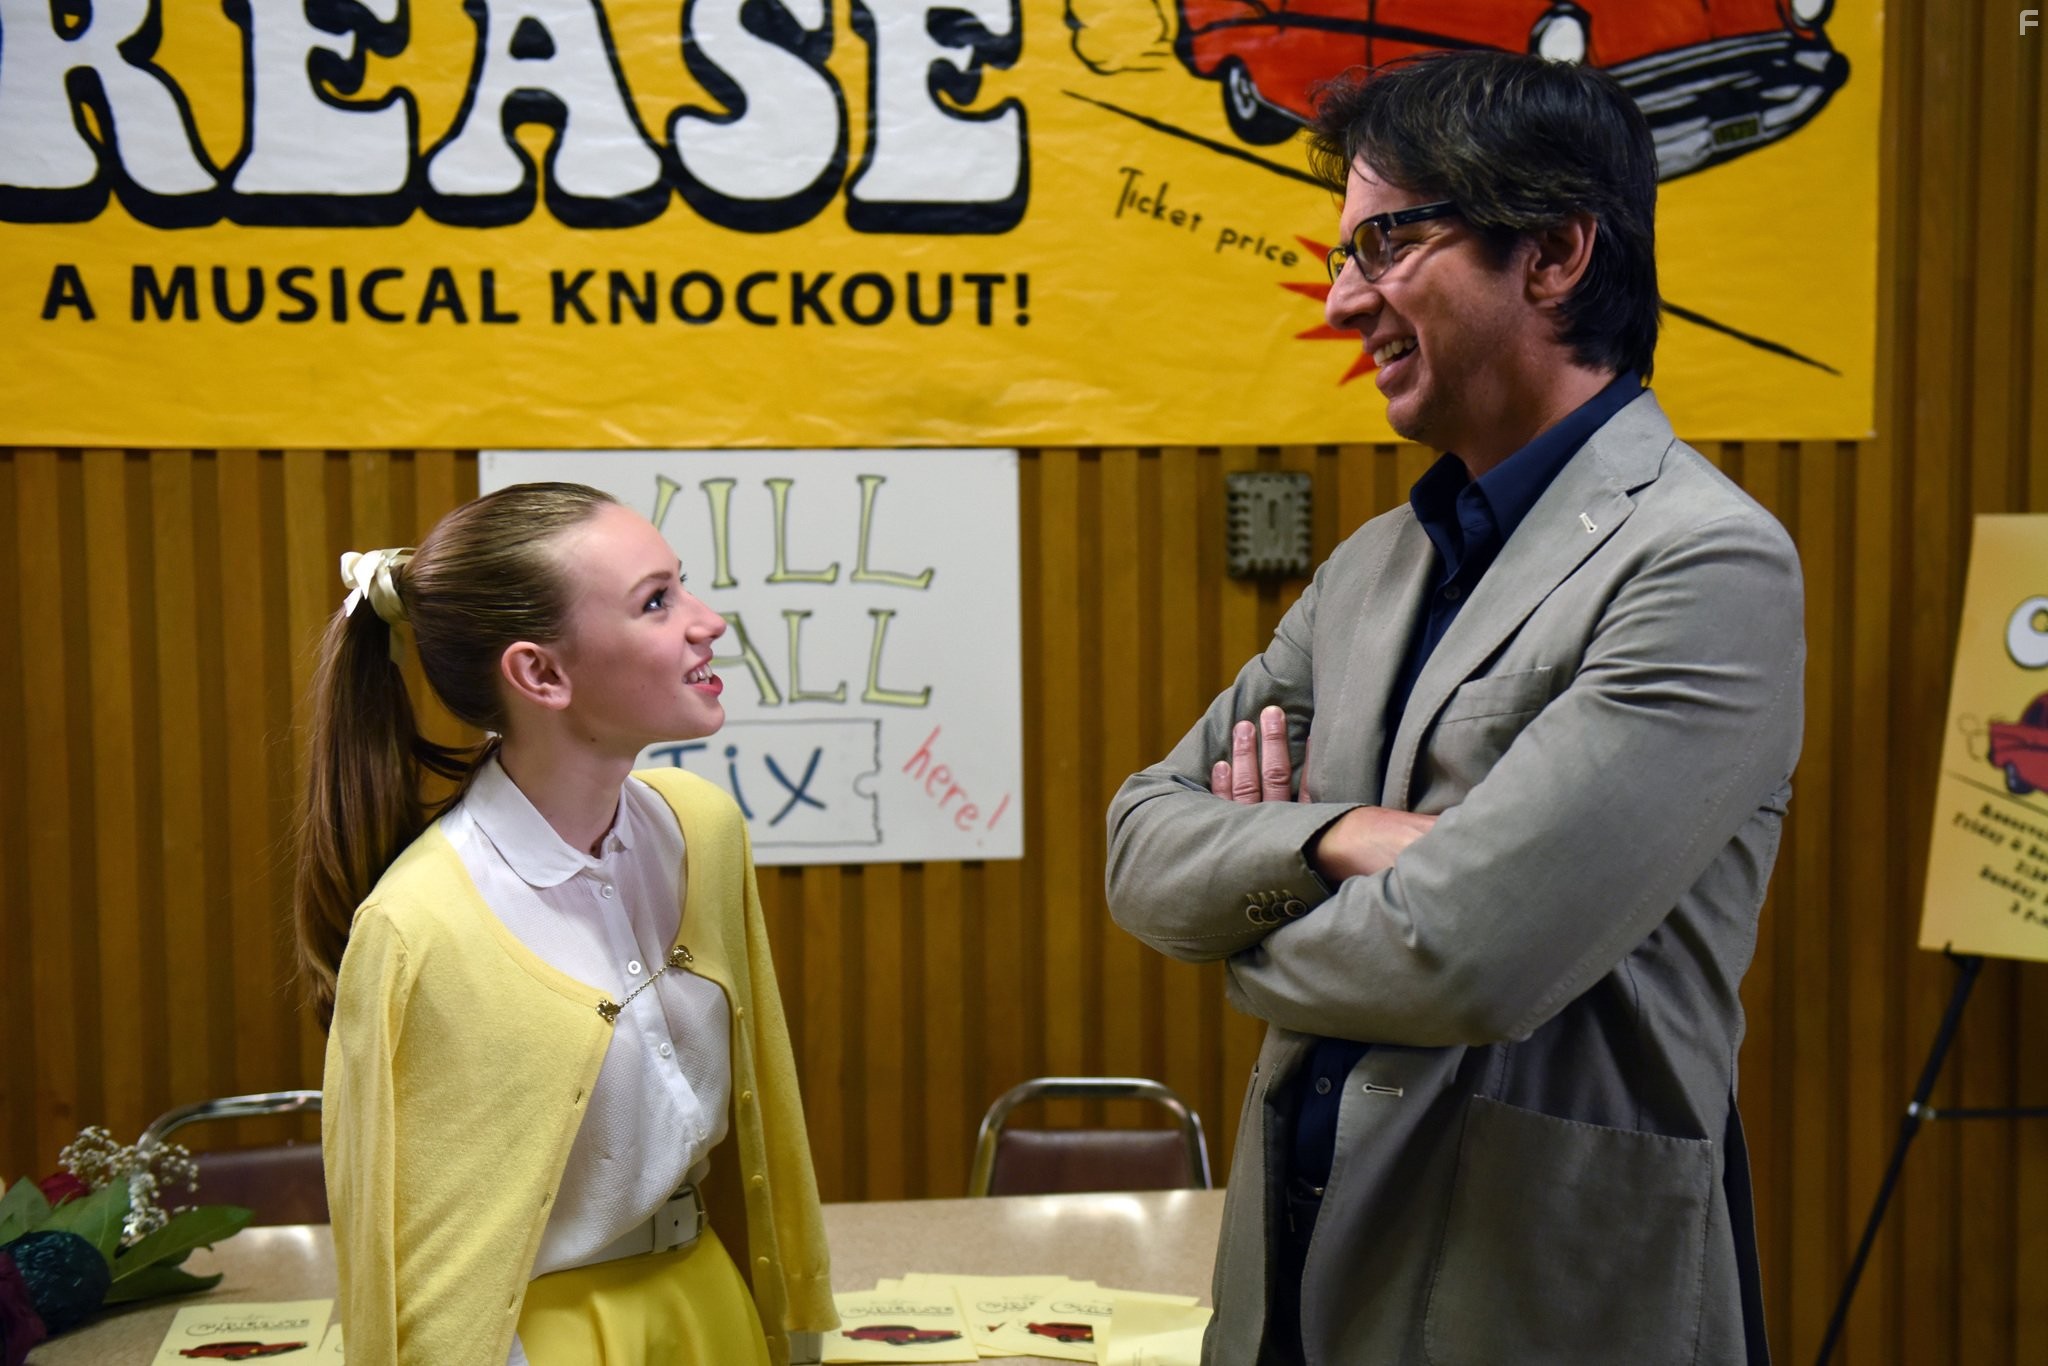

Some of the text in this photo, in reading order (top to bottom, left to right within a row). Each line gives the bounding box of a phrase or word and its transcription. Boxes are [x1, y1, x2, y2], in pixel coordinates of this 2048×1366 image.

[1115, 166, 1299, 267] Ticket price
[40, 263, 1031, 327] A MUSICAL KNOCKOUT!
[902, 725, 1011, 848] here!
